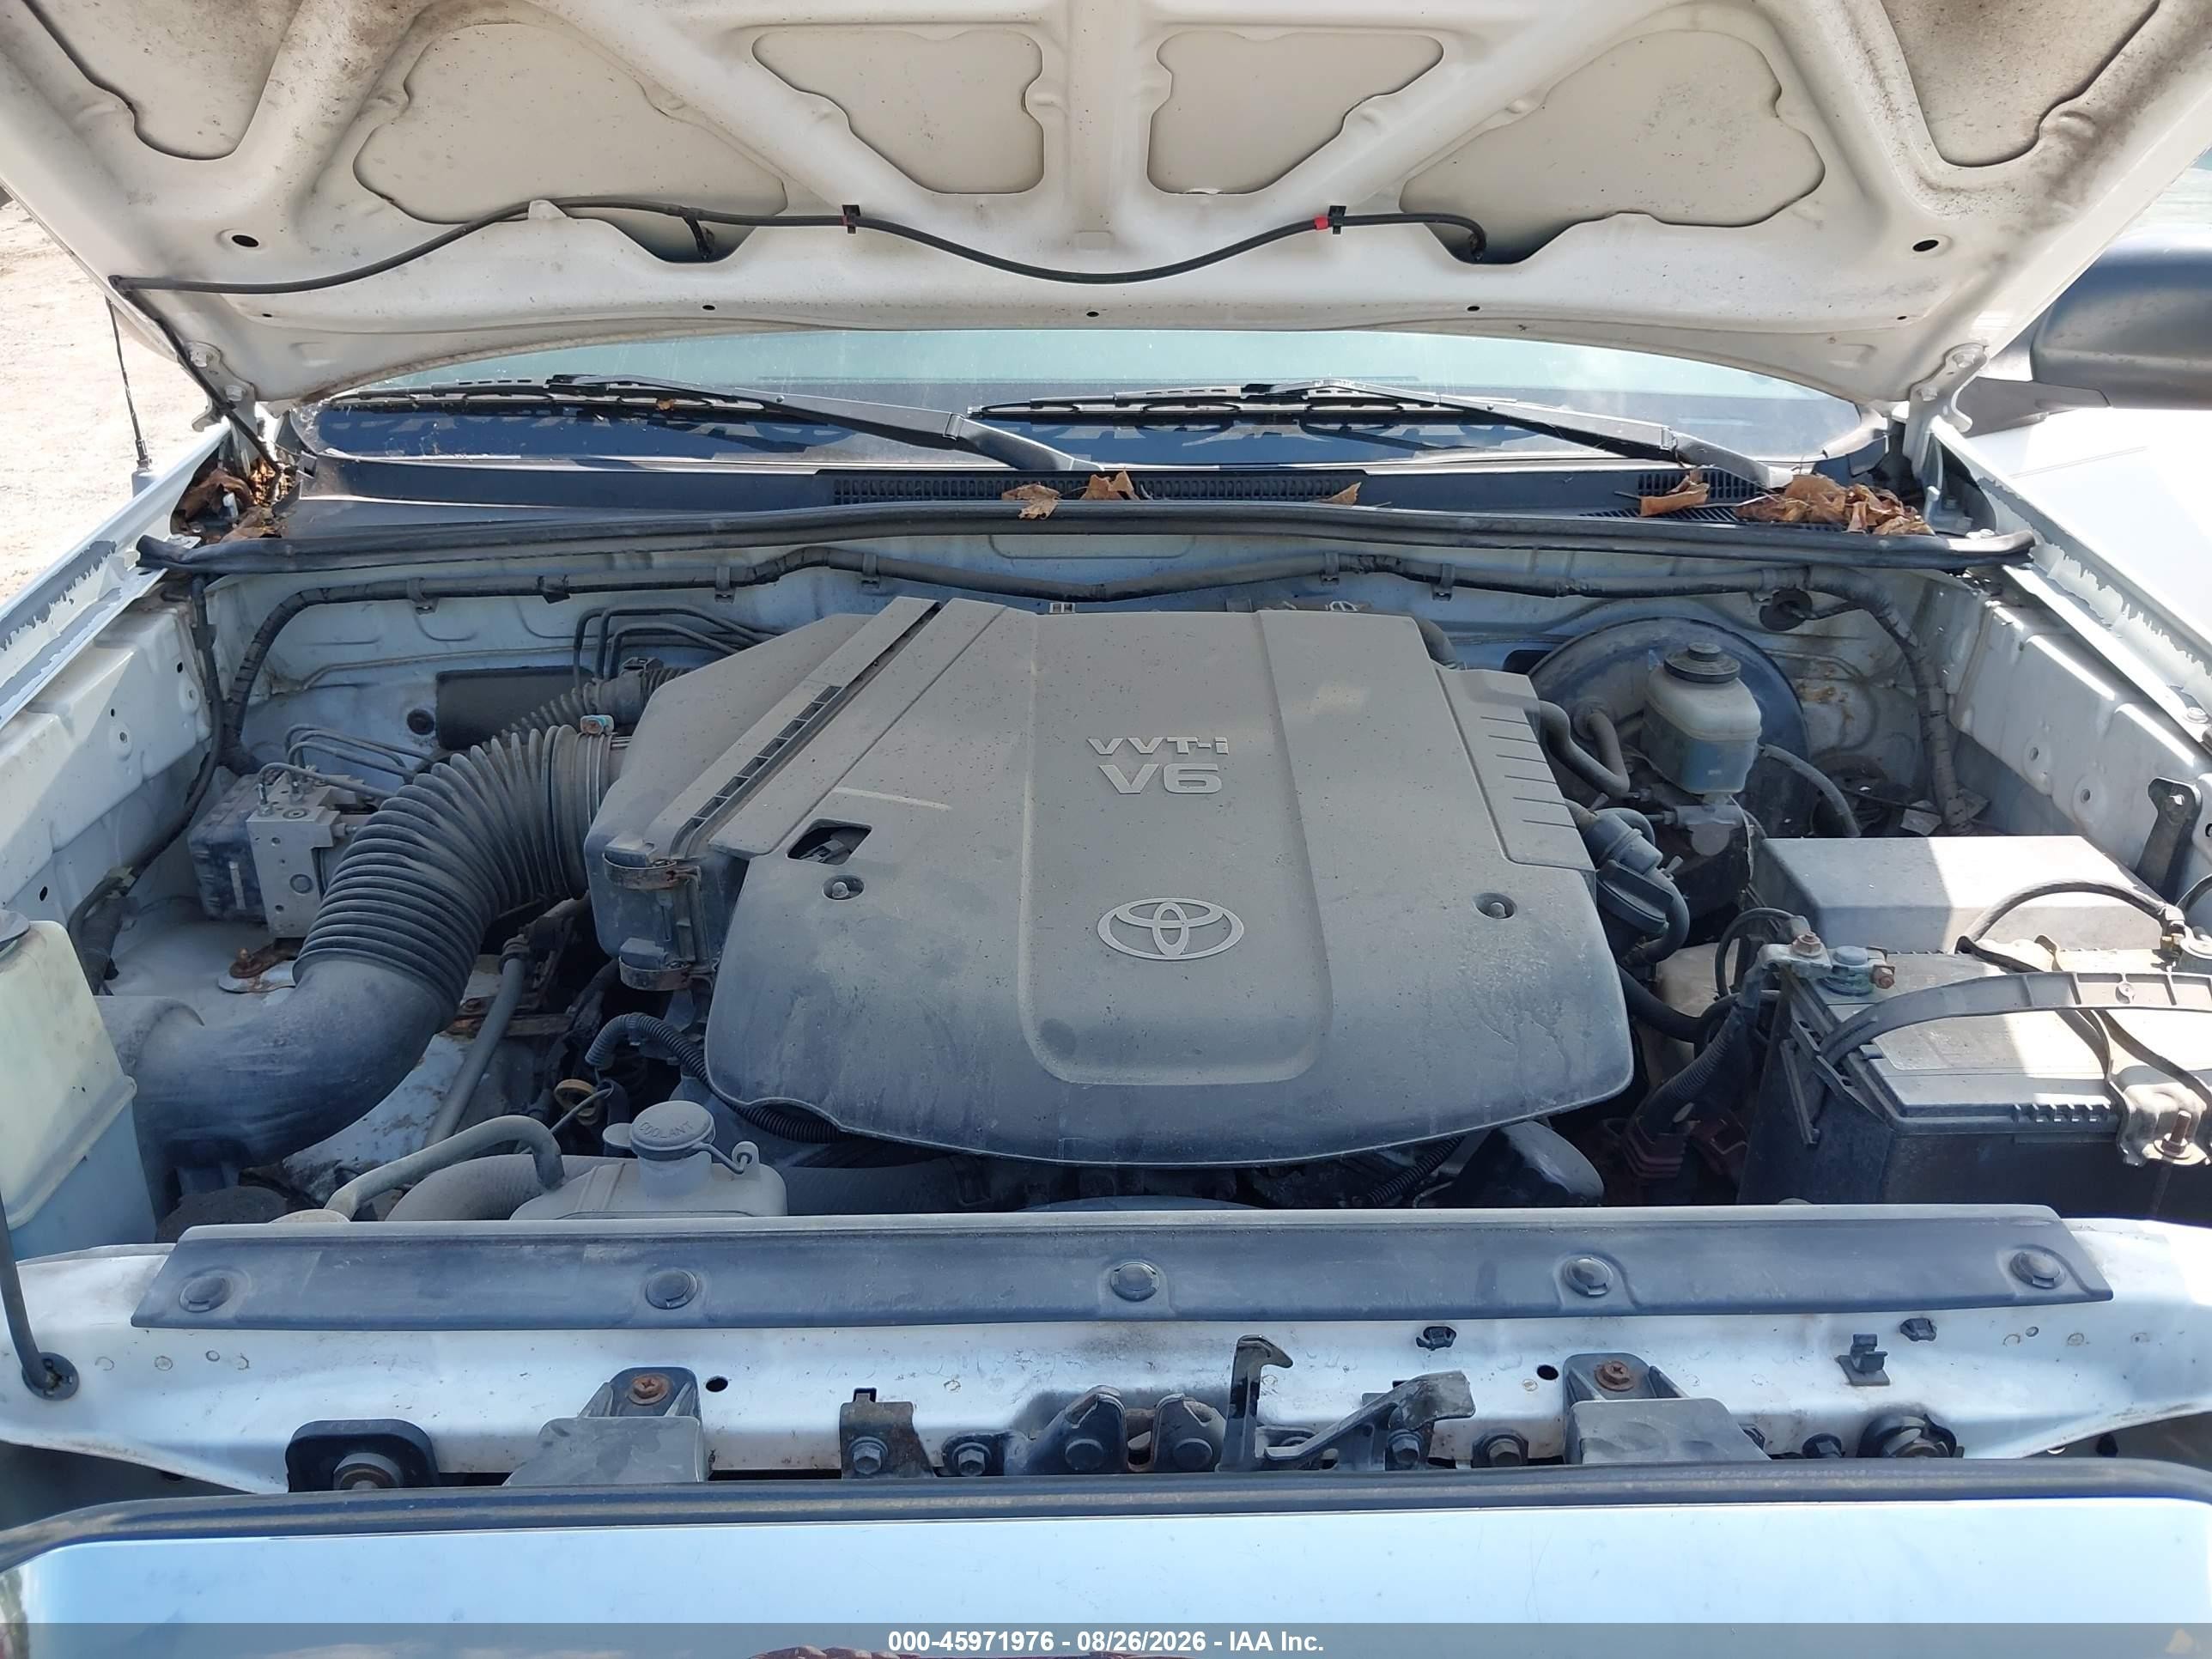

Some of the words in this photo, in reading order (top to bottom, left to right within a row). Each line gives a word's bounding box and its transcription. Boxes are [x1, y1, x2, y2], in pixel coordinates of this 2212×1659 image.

[1086, 737, 1230, 756] VVT-i
[1098, 763, 1223, 794] V6
[639, 1120, 694, 1139] COOLANT
